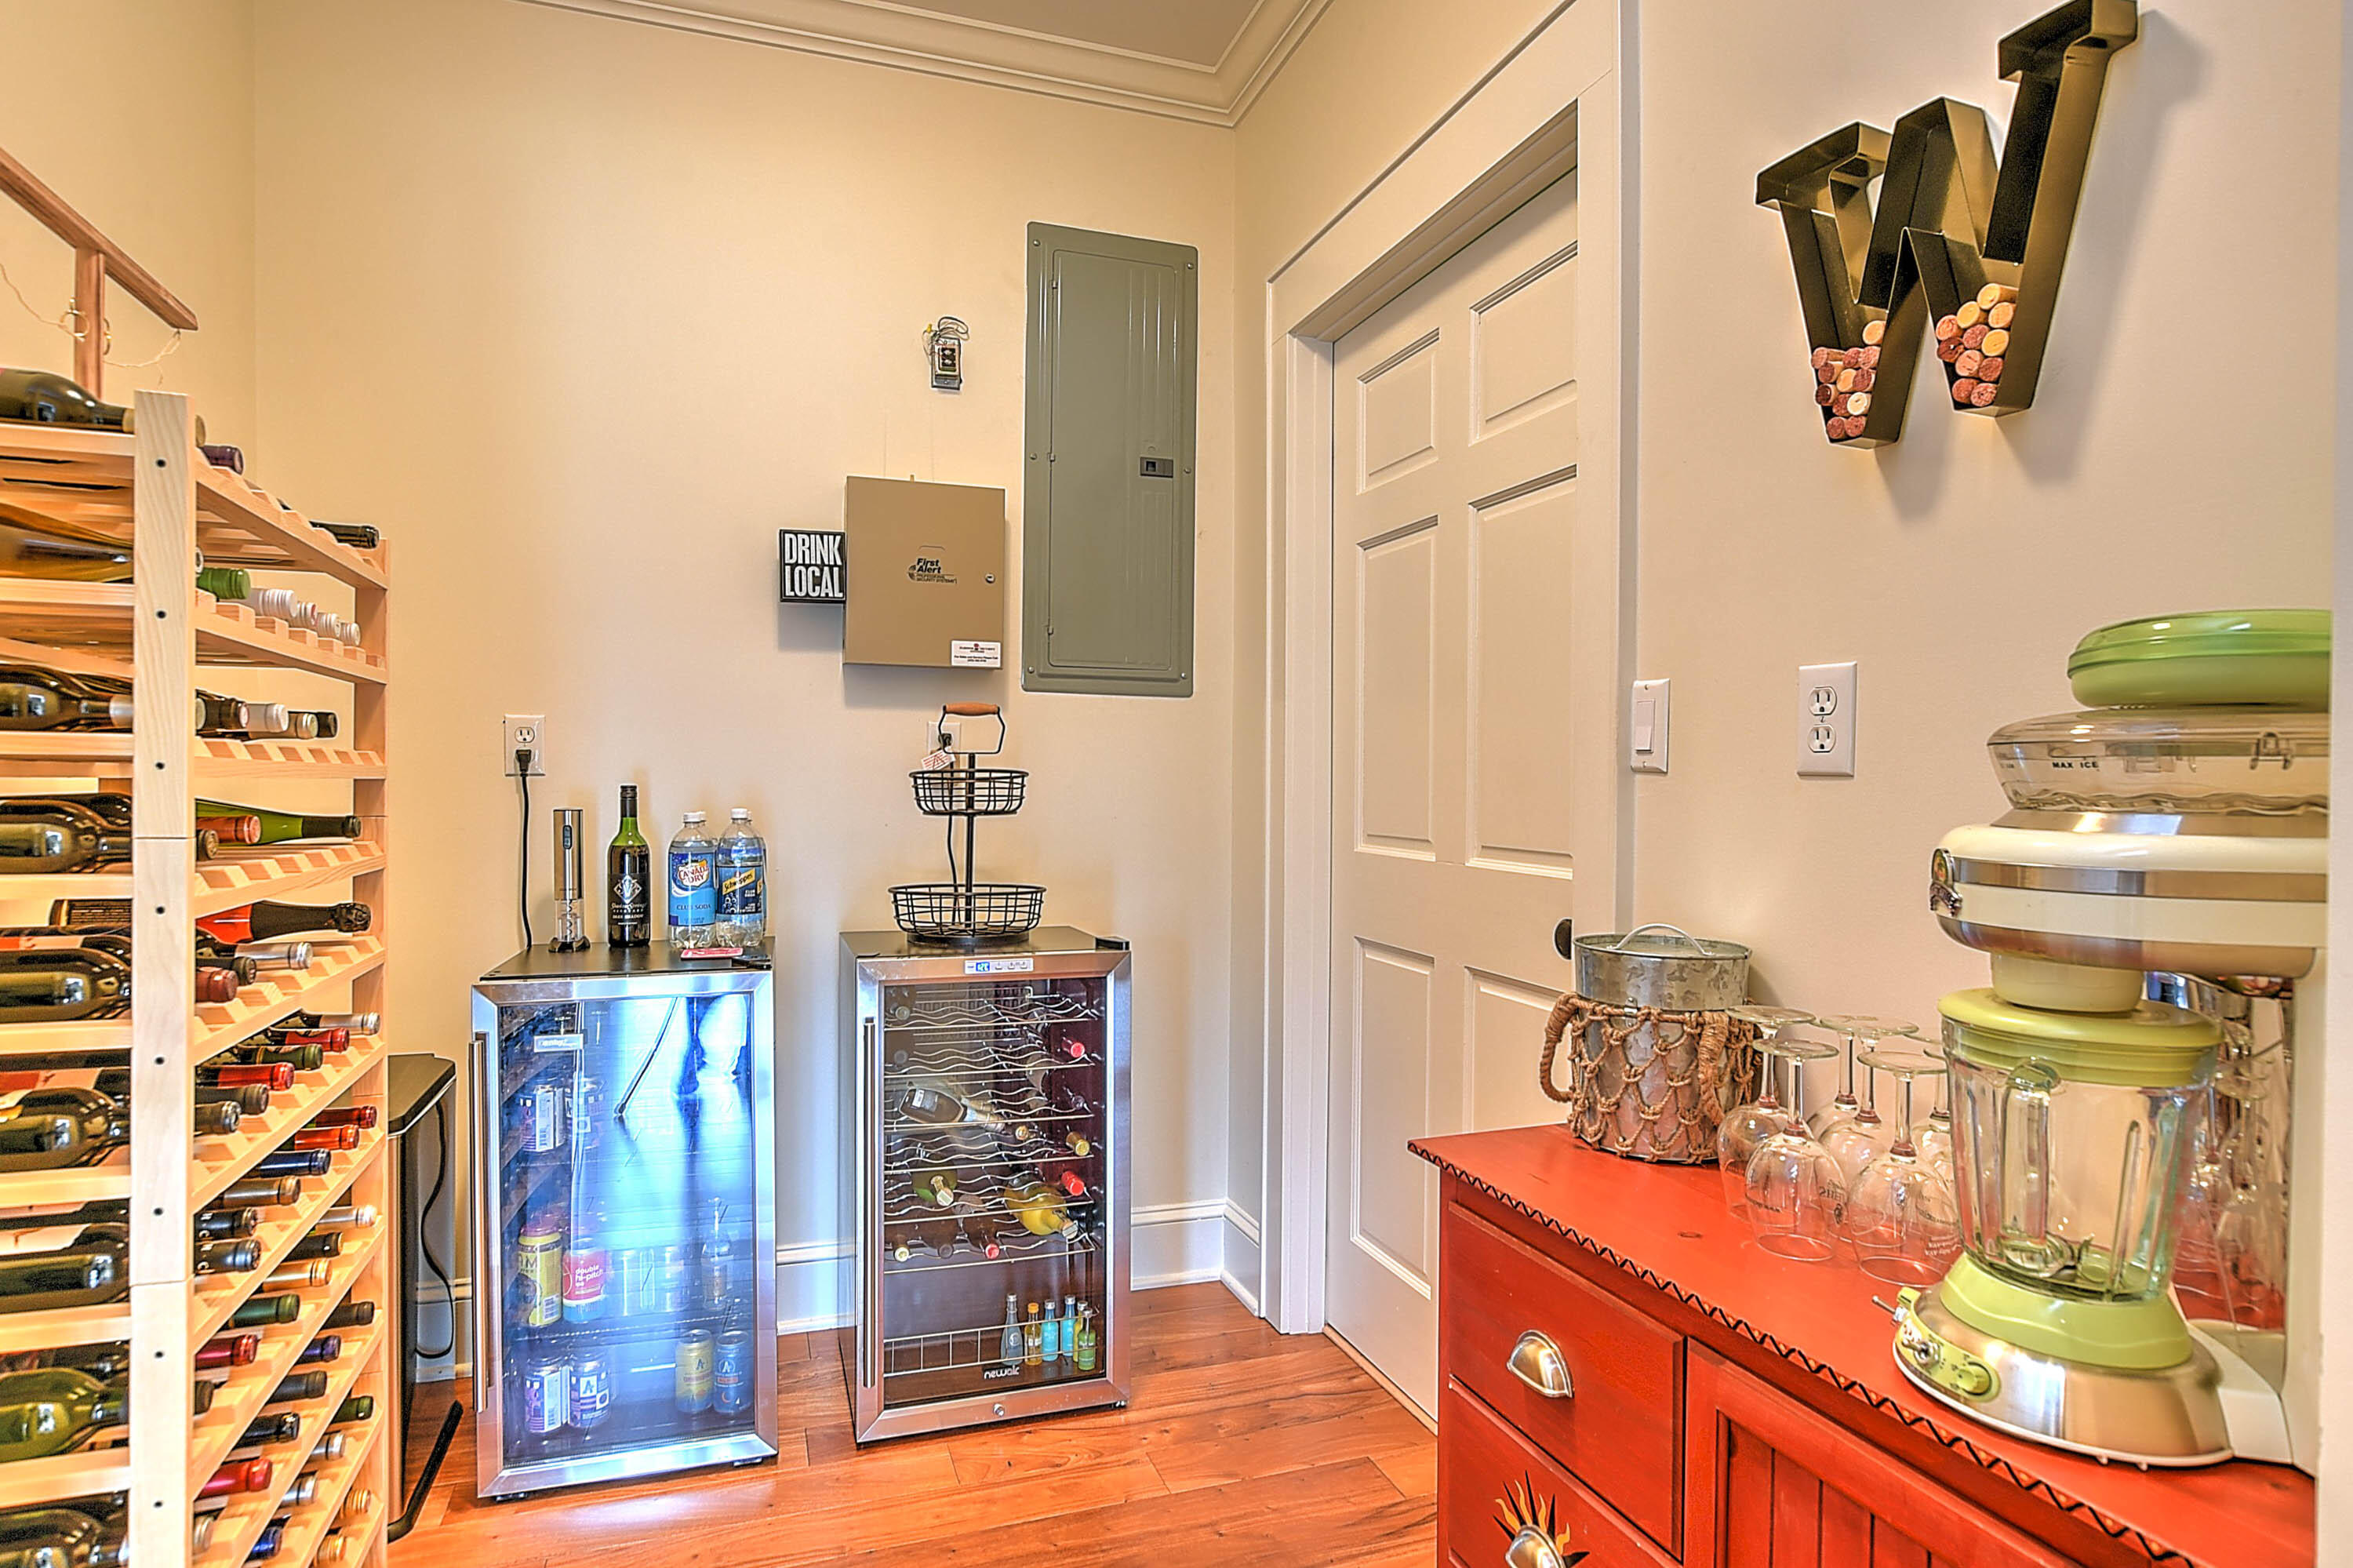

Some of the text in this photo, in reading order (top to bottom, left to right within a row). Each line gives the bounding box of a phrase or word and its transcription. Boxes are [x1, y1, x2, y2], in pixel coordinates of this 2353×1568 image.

[784, 533, 842, 565] DRINK
[917, 558, 939, 566] First
[917, 565, 941, 573] Alert
[785, 566, 843, 598] LOCAL
[689, 873, 705, 883] DRY
[575, 1264, 600, 1275] double
